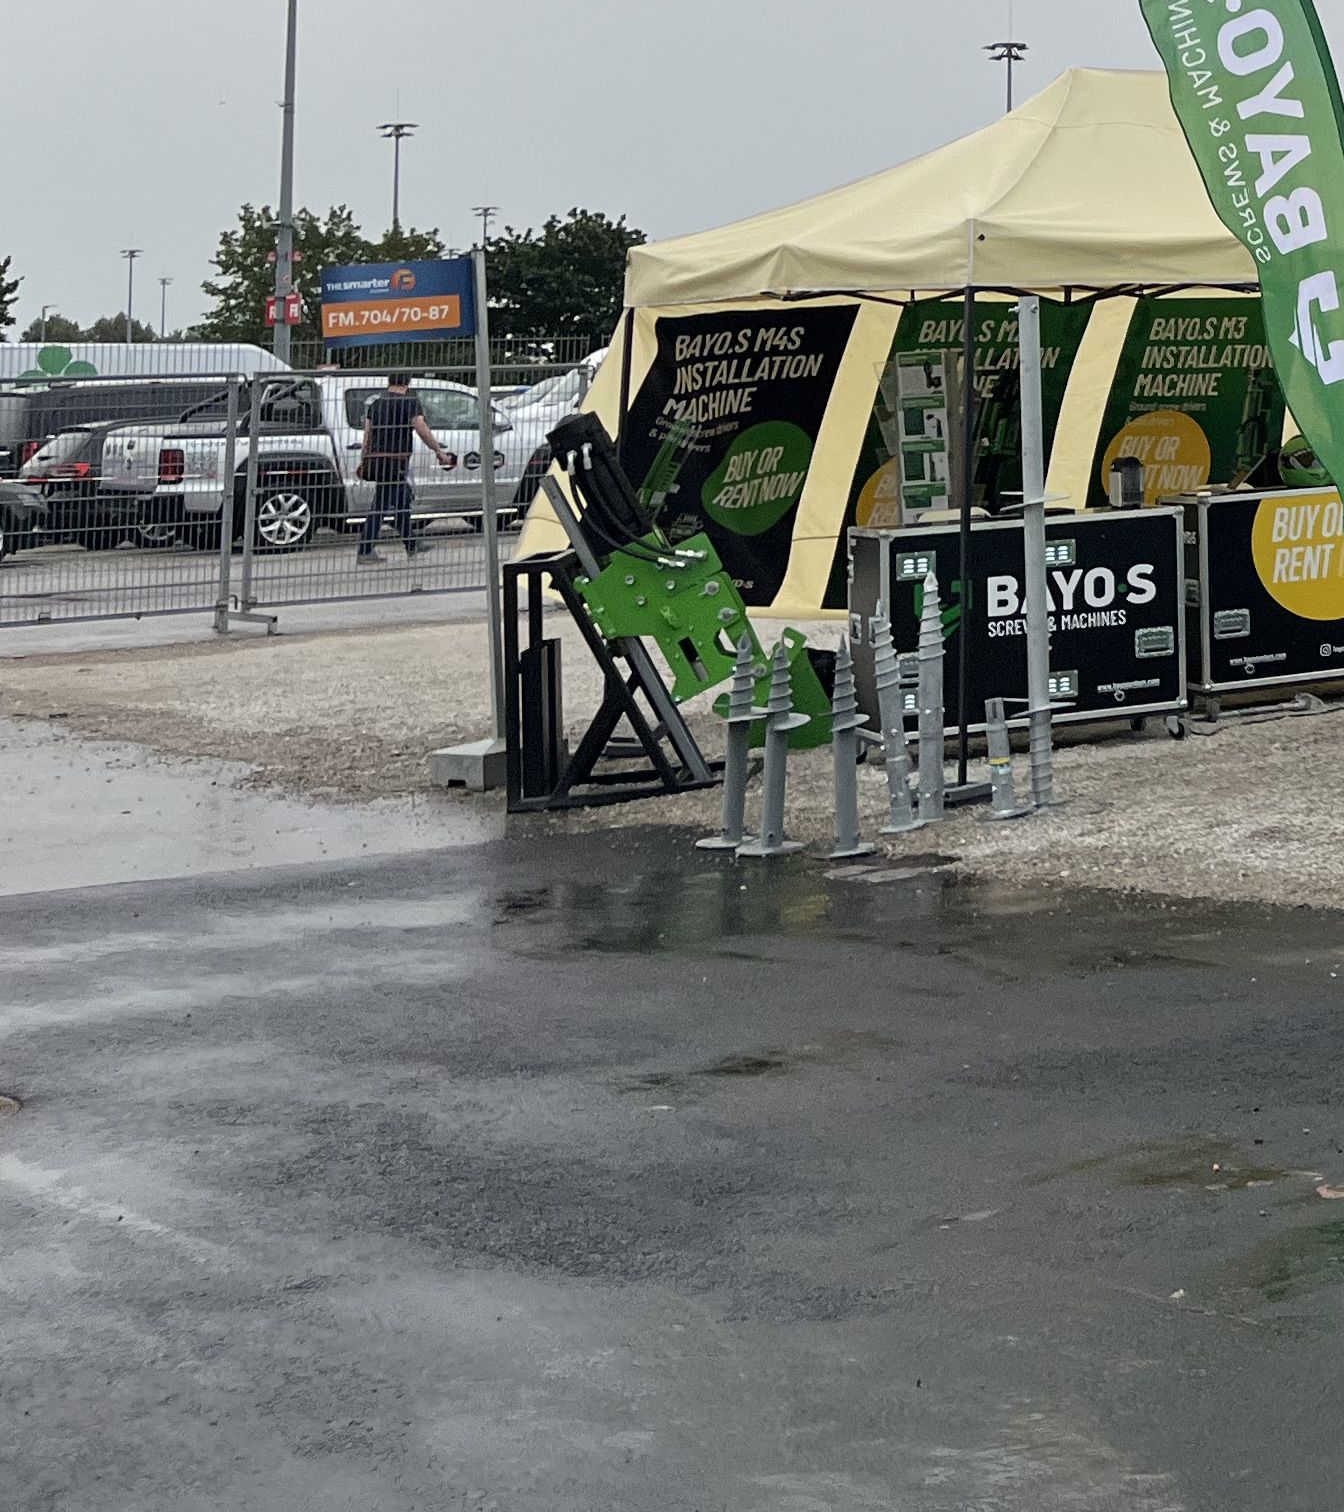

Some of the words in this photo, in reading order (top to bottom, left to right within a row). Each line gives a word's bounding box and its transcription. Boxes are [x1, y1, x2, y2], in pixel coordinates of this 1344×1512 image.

[343, 278, 390, 290] smarter
[328, 305, 449, 328] FM.704/70-87
[1149, 317, 1218, 341] BAYO.S
[1219, 317, 1249, 339] M3
[999, 321, 1020, 342] M
[675, 329, 752, 362] BAYO.S
[754, 327, 805, 352] M4S
[673, 353, 824, 395] INSTALLATION
[1133, 373, 1223, 397] MACHINE
[662, 387, 758, 423] MACHINE
[1154, 436, 1180, 461] OR
[724, 451, 757, 483] BUY
[757, 446, 784, 475] OR
[1272, 504, 1320, 543] BUY
[1272, 543, 1335, 584] RENT
[1061, 609, 1127, 630] MACHINES
